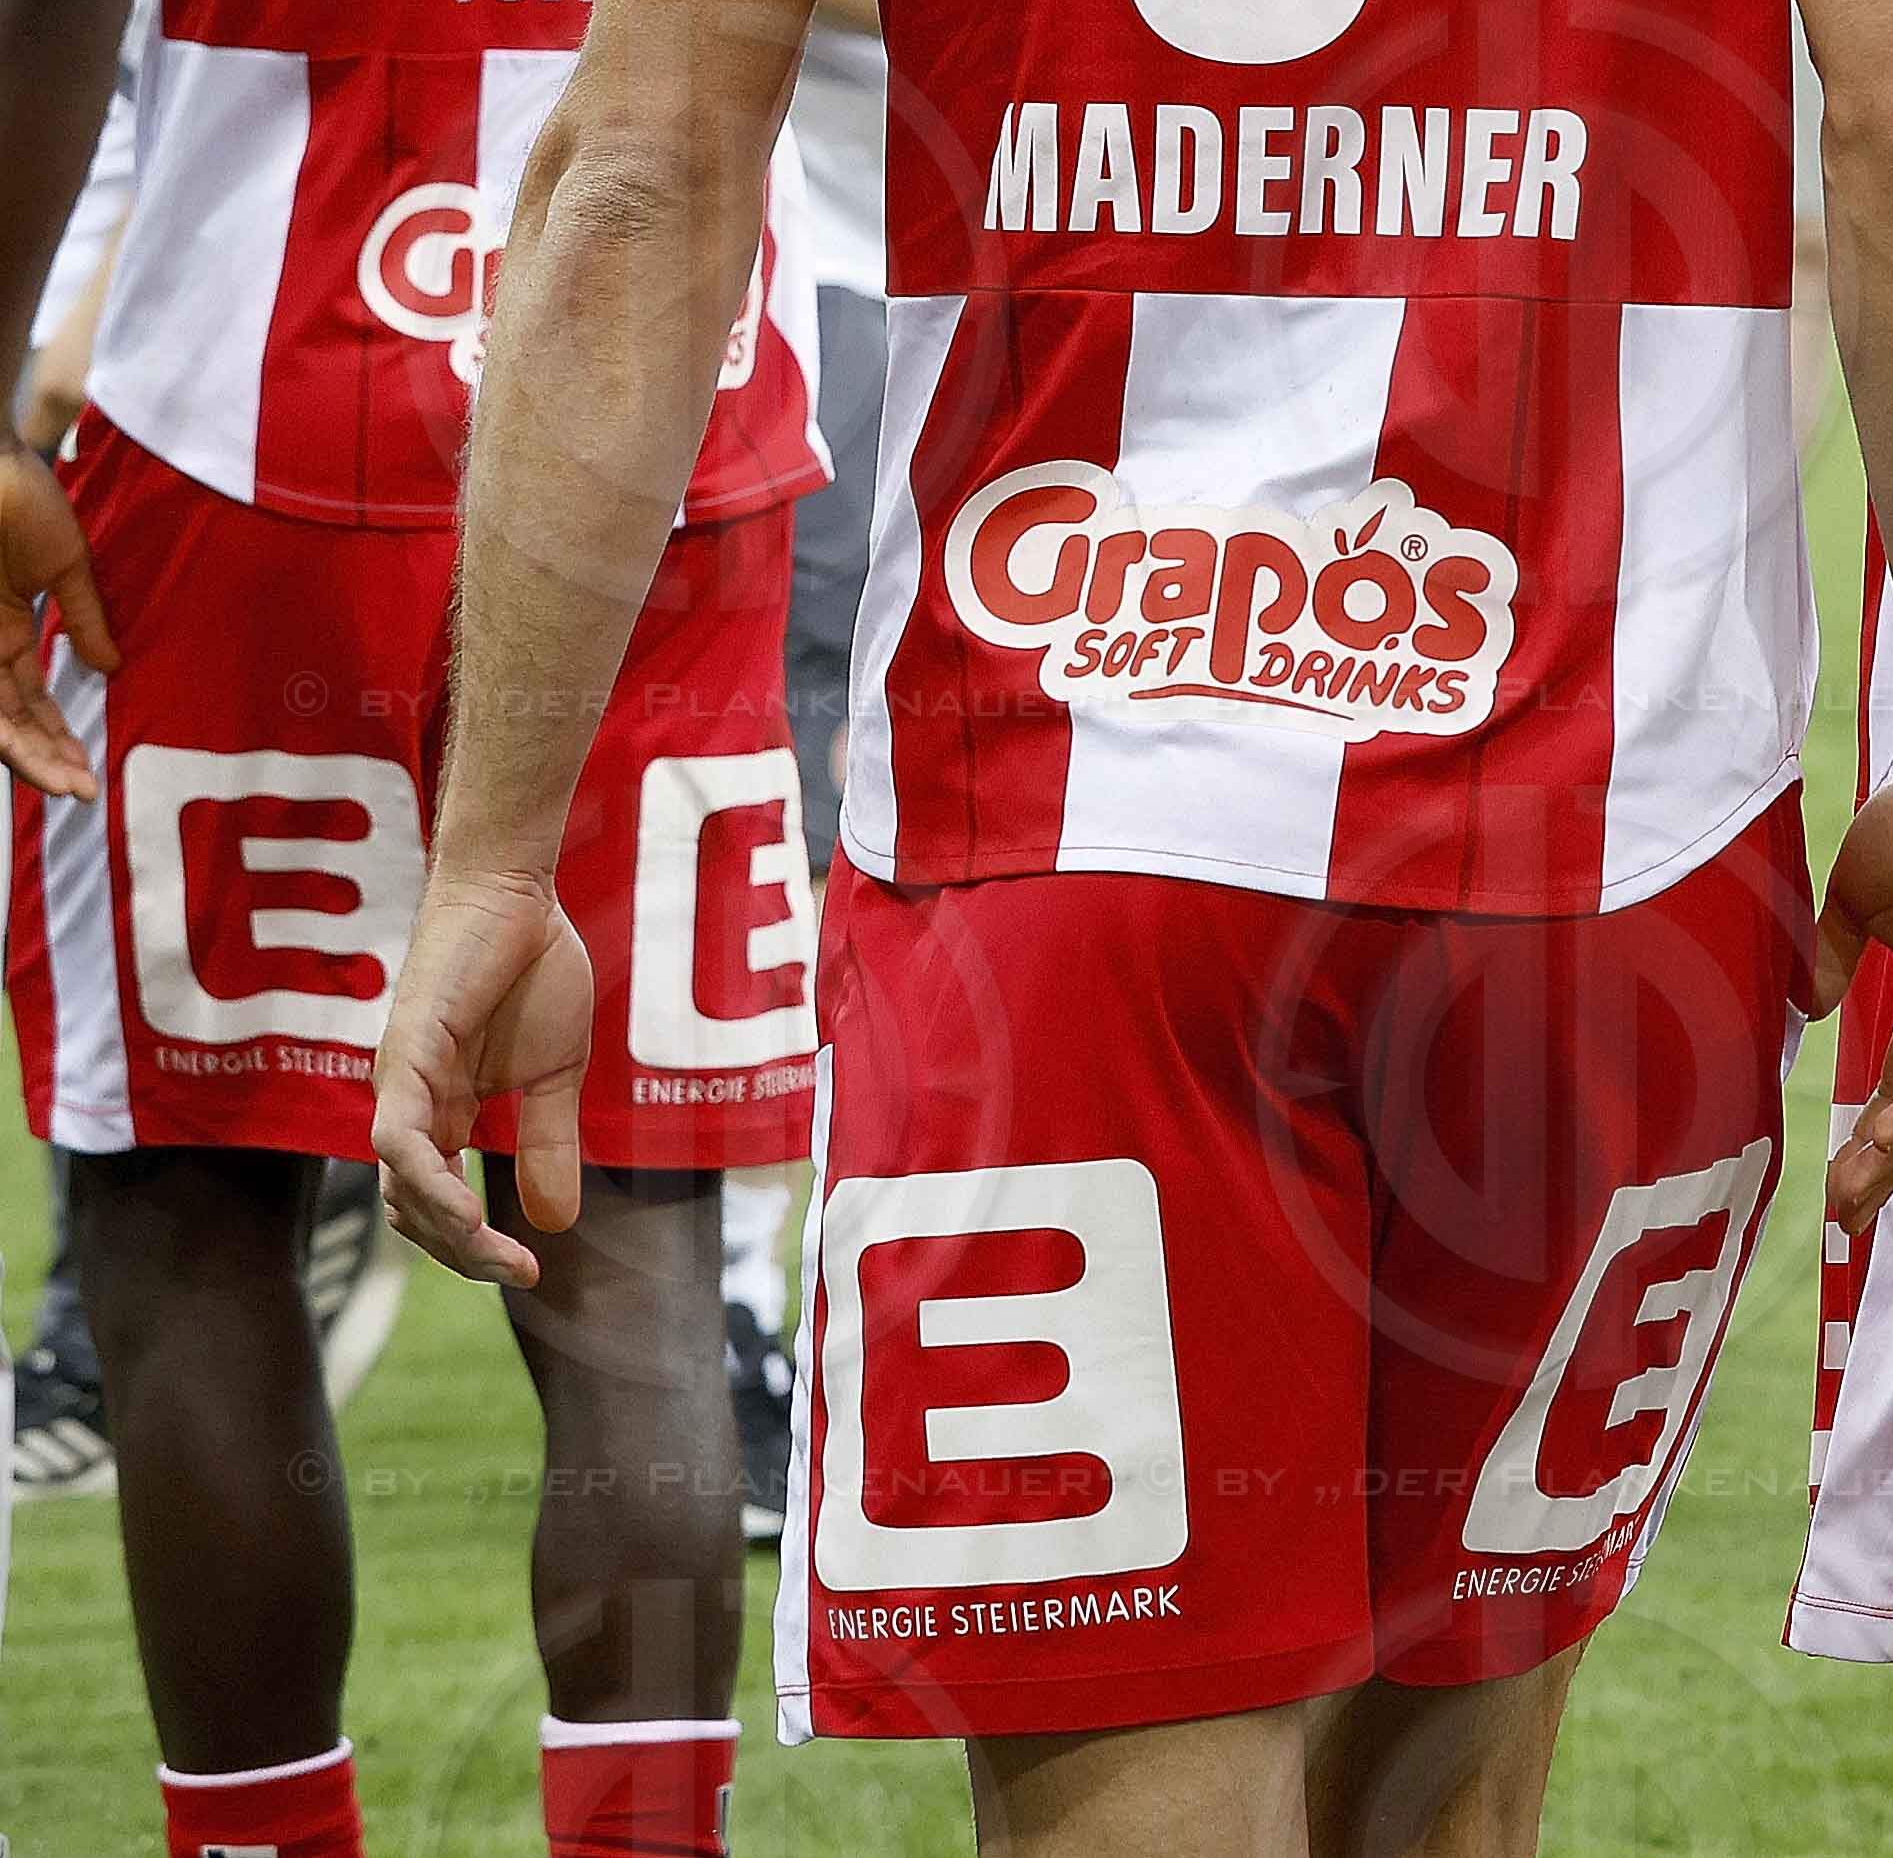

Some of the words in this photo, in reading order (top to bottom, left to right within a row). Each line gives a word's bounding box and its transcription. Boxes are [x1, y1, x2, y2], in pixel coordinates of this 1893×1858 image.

[983, 101, 1588, 241] MADERNER
[1063, 627, 1205, 678] SOFT
[1255, 642, 1470, 714] DRINKS
[827, 1605, 939, 1640] ENERGIE
[953, 1585, 1183, 1636] STEIERMARK
[1452, 1565, 1566, 1601] ENERGIE
